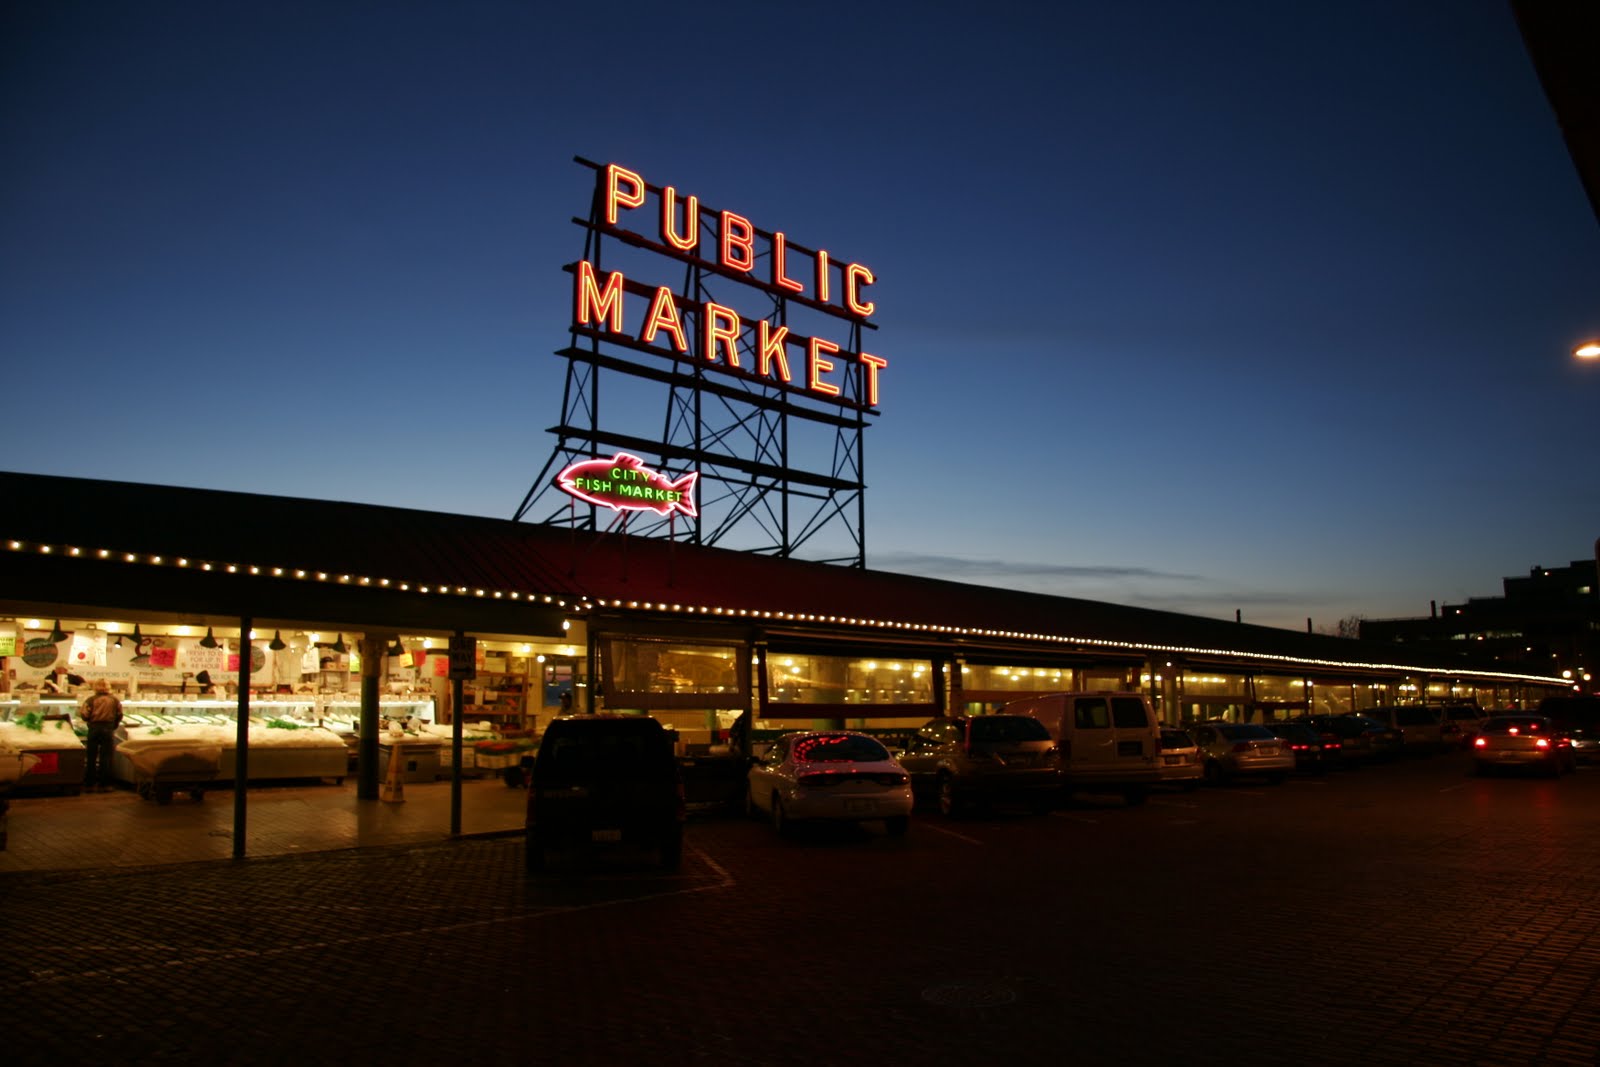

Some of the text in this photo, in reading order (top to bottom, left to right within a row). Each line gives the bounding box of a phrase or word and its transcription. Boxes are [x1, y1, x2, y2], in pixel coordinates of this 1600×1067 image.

[606, 163, 874, 317] PUBLIC
[577, 260, 887, 405] MARKET
[575, 477, 683, 502] FISH MARKET
[612, 467, 651, 482] CITY
